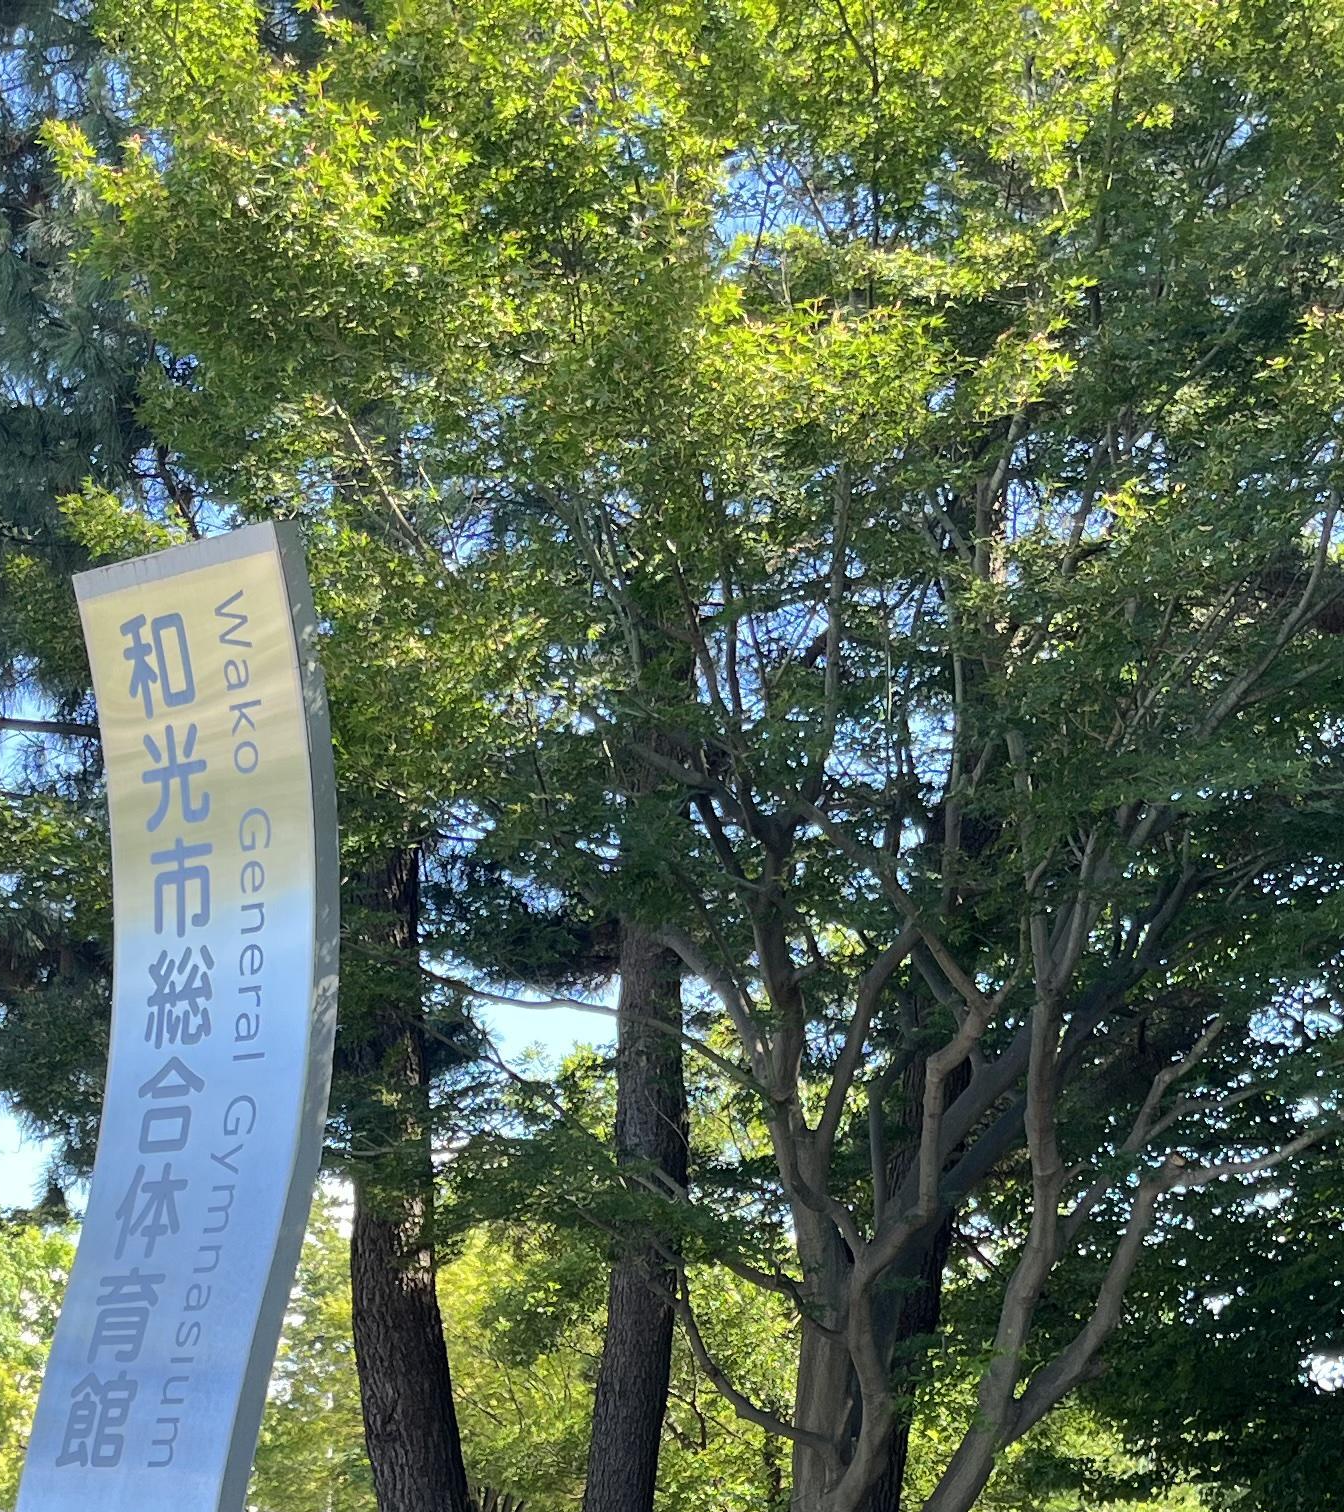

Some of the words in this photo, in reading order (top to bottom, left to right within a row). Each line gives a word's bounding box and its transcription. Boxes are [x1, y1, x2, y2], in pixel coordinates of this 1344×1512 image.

[213, 589, 262, 774] Wako
[57, 612, 214, 1467] 和光市総合体育館
[232, 807, 271, 1062] General
[147, 1094, 256, 1468] Gymnasium
